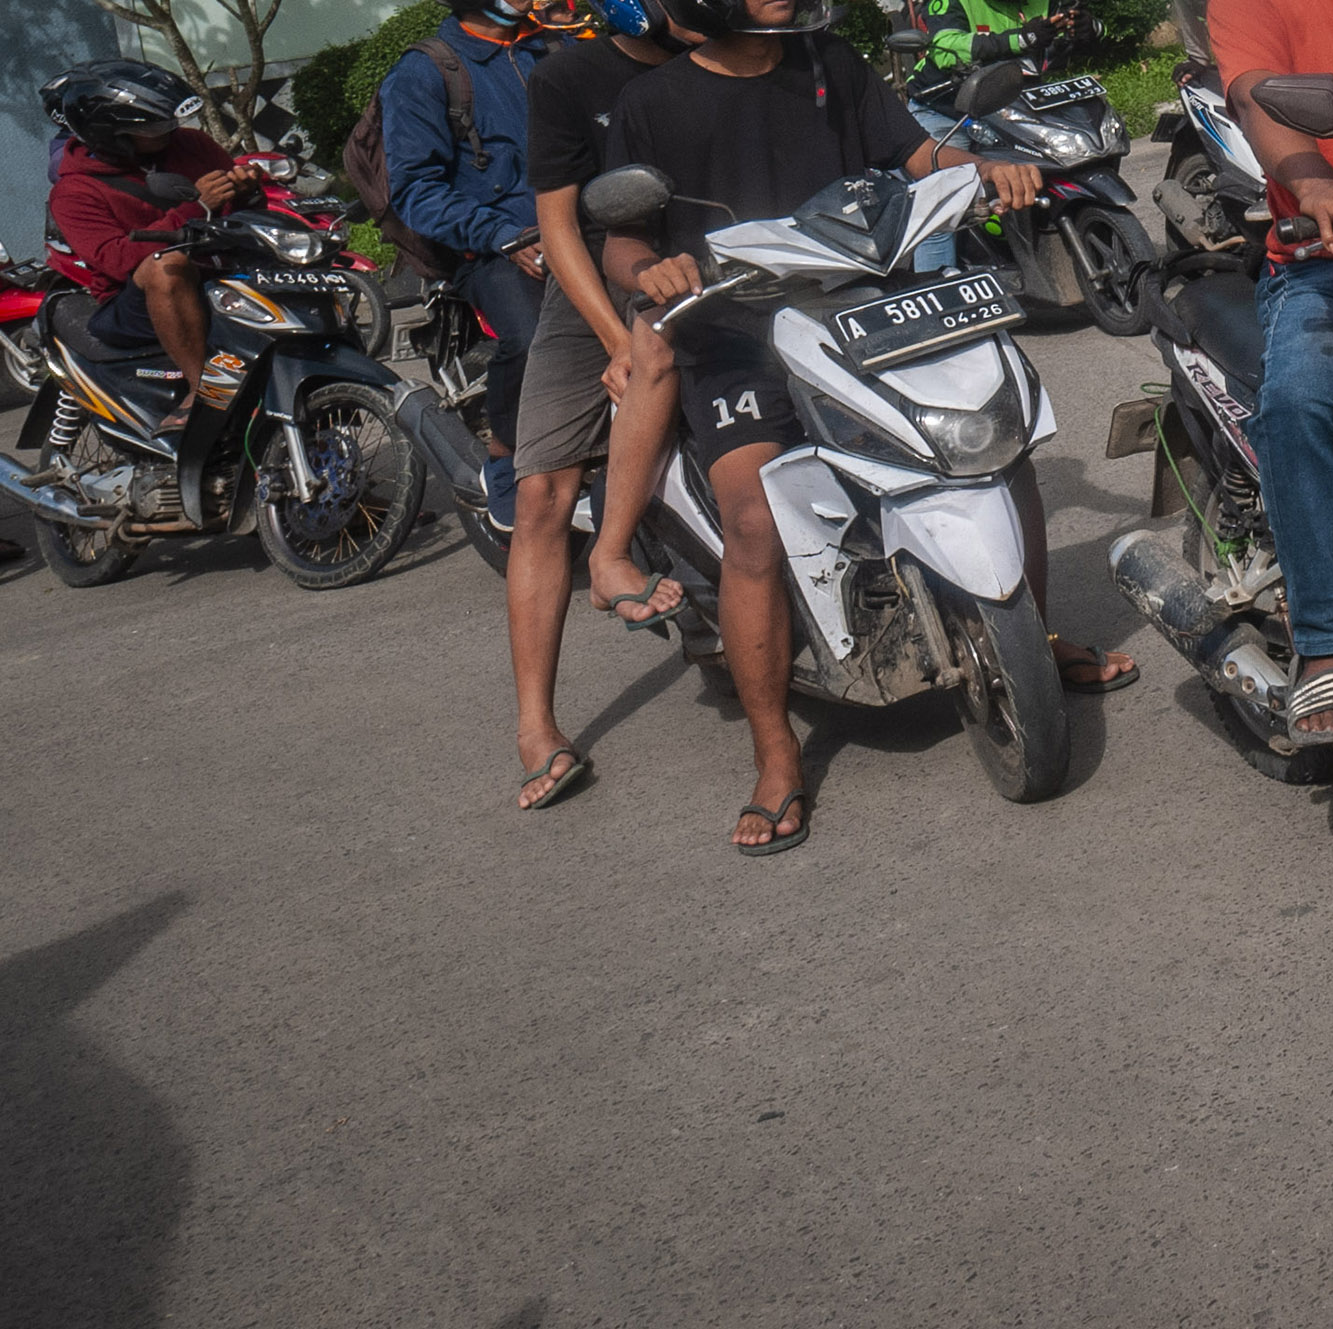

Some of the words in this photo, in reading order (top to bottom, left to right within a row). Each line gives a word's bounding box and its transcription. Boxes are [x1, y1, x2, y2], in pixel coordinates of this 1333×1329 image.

[1025, 92, 1038, 102] A
[257, 273, 271, 285] A
[848, 317, 867, 340] A
[884, 292, 944, 325] 5811
[712, 390, 763, 430] 14
